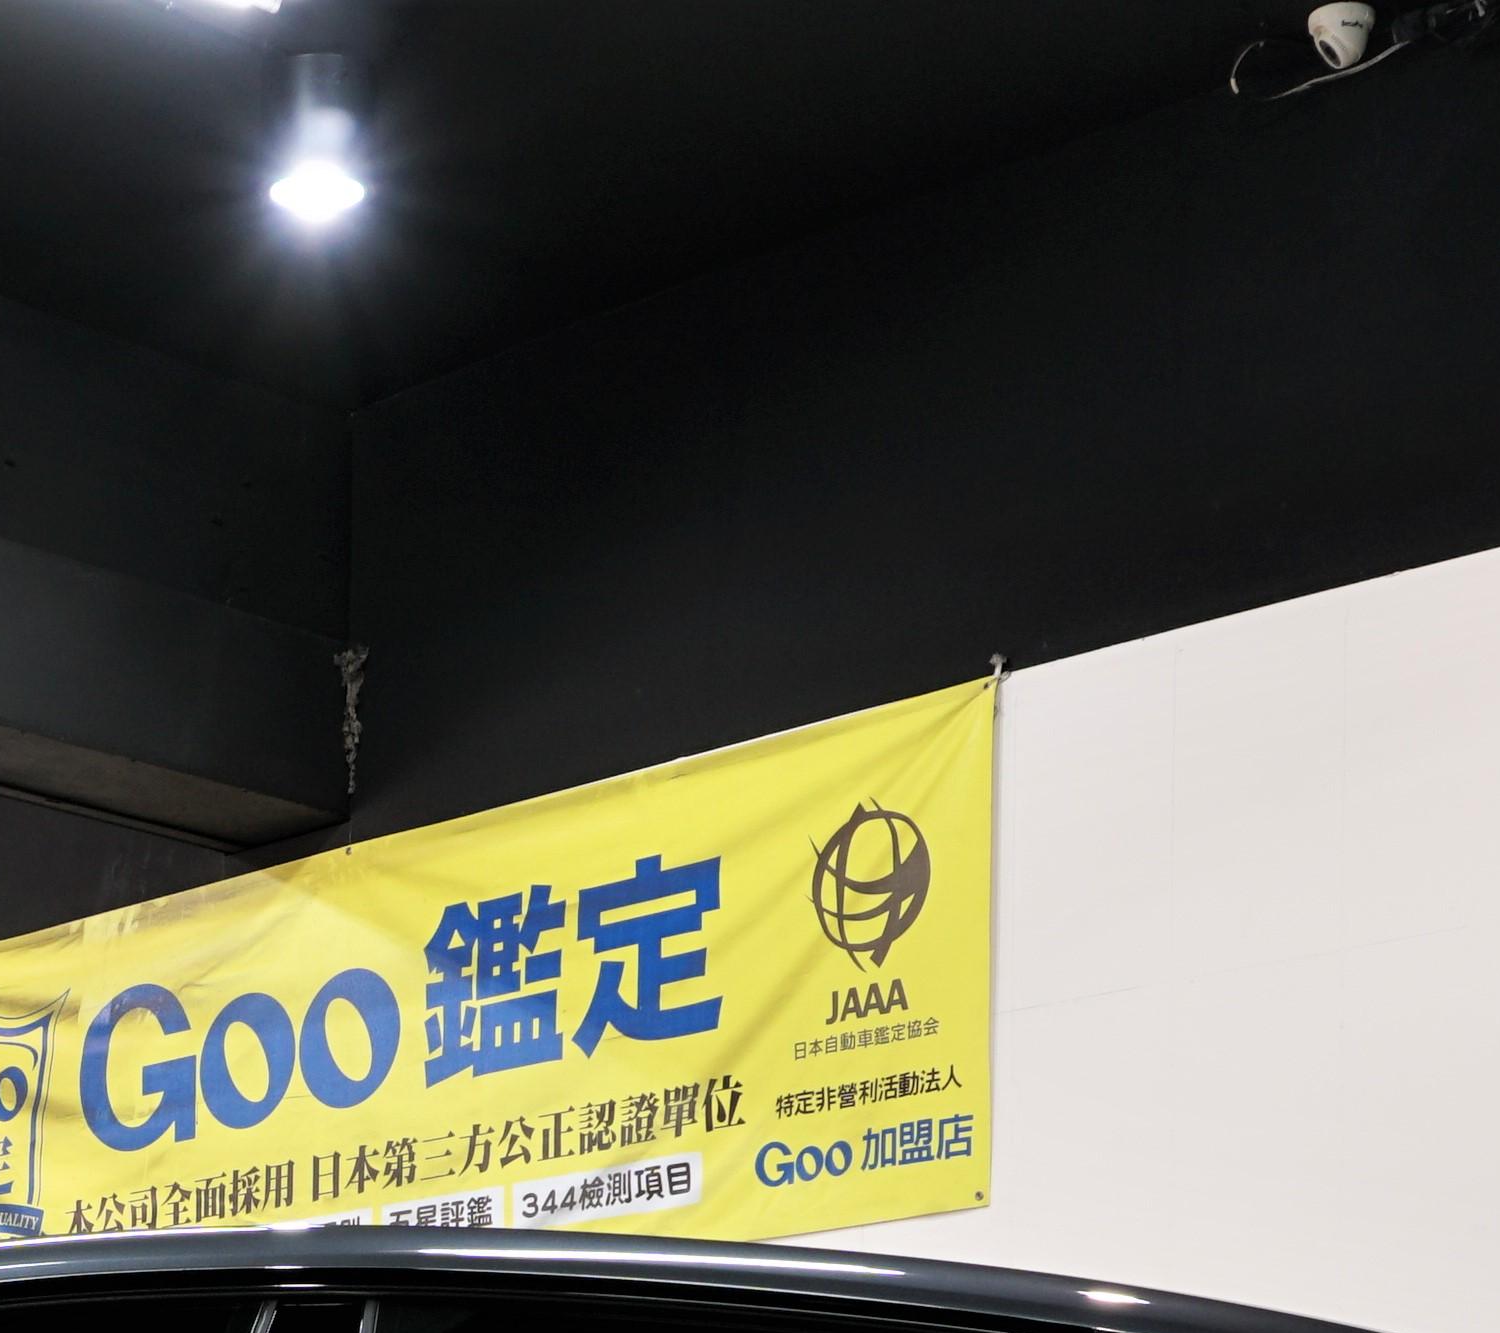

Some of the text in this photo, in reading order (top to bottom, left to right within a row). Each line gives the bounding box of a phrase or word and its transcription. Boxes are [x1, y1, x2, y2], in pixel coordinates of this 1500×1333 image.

[79, 853, 723, 1152] Goo 鑑定
[826, 979, 909, 1025] JAAA
[794, 1017, 939, 1060] 日本自動車鑑定協会
[775, 1064, 962, 1119] 特定非營利活動法人
[65, 1074, 745, 1234] 本公司全面採用 日本第三方公正認證單位
[754, 1114, 974, 1187] Goo 加盟店
[522, 1162, 691, 1218] 344檢測項目
